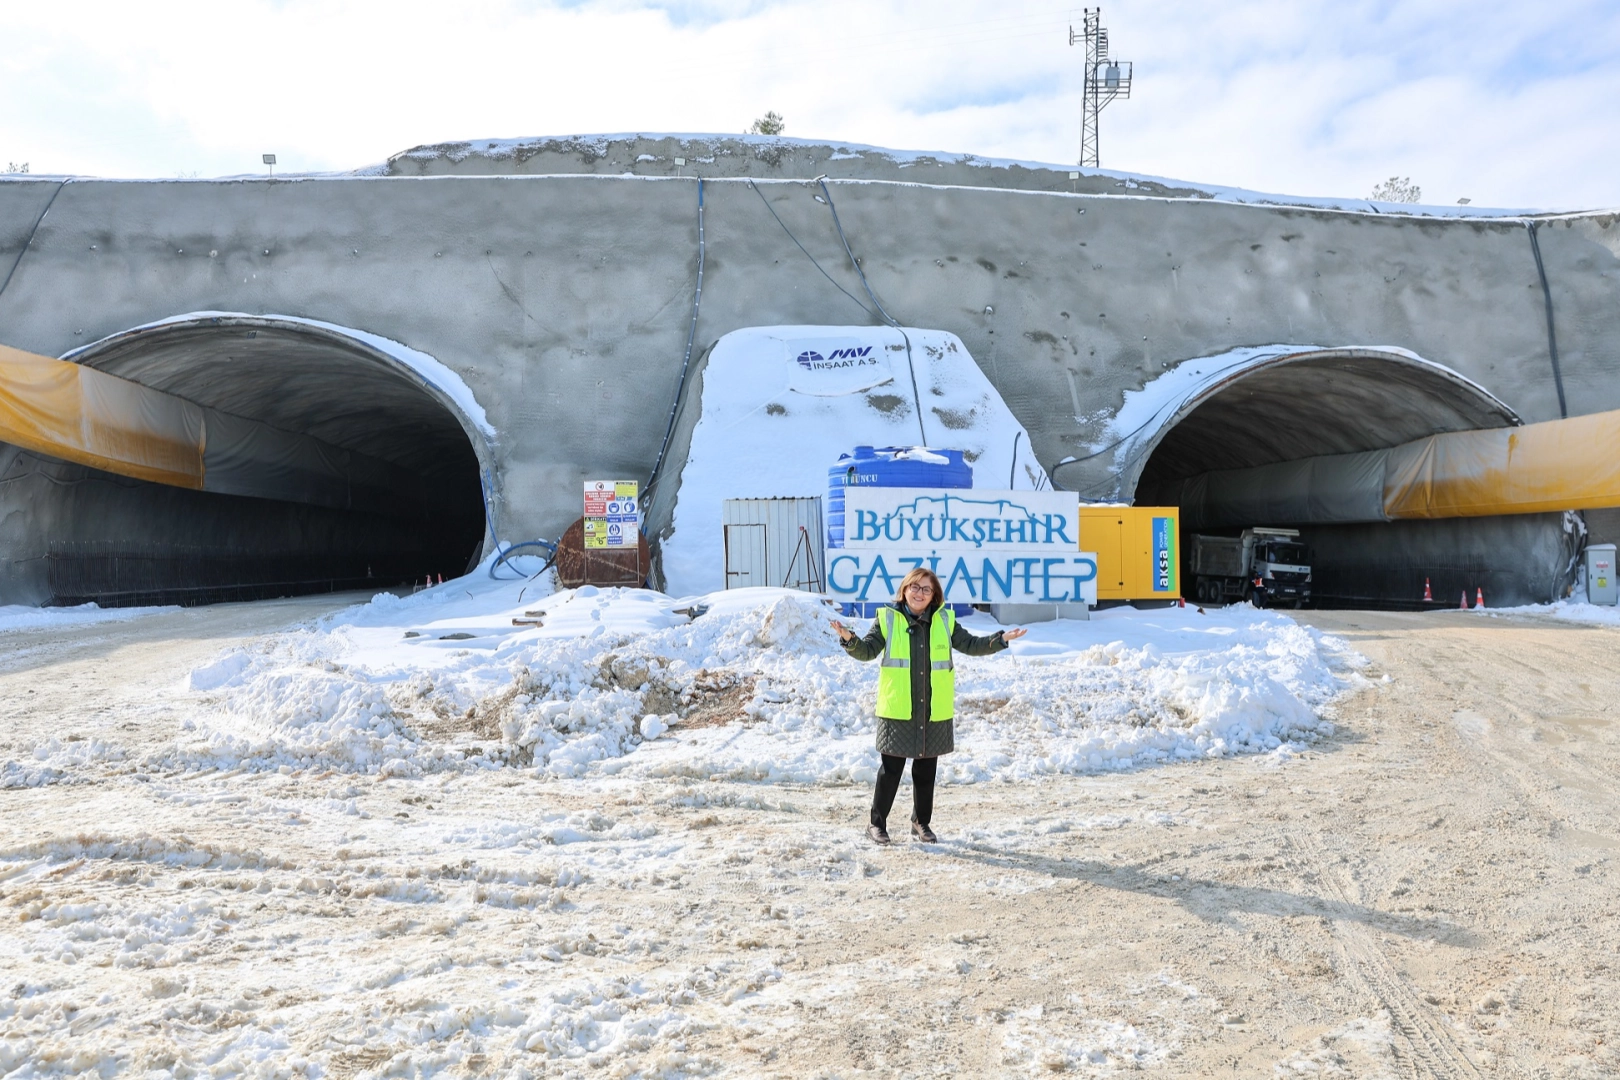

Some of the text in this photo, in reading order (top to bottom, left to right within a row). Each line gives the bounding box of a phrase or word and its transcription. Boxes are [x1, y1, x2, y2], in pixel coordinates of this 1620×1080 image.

[813, 360, 855, 371] İNŞAAT
[850, 509, 1077, 548] BÜYÜKŞEHİR
[1160, 550, 1168, 587] aksa
